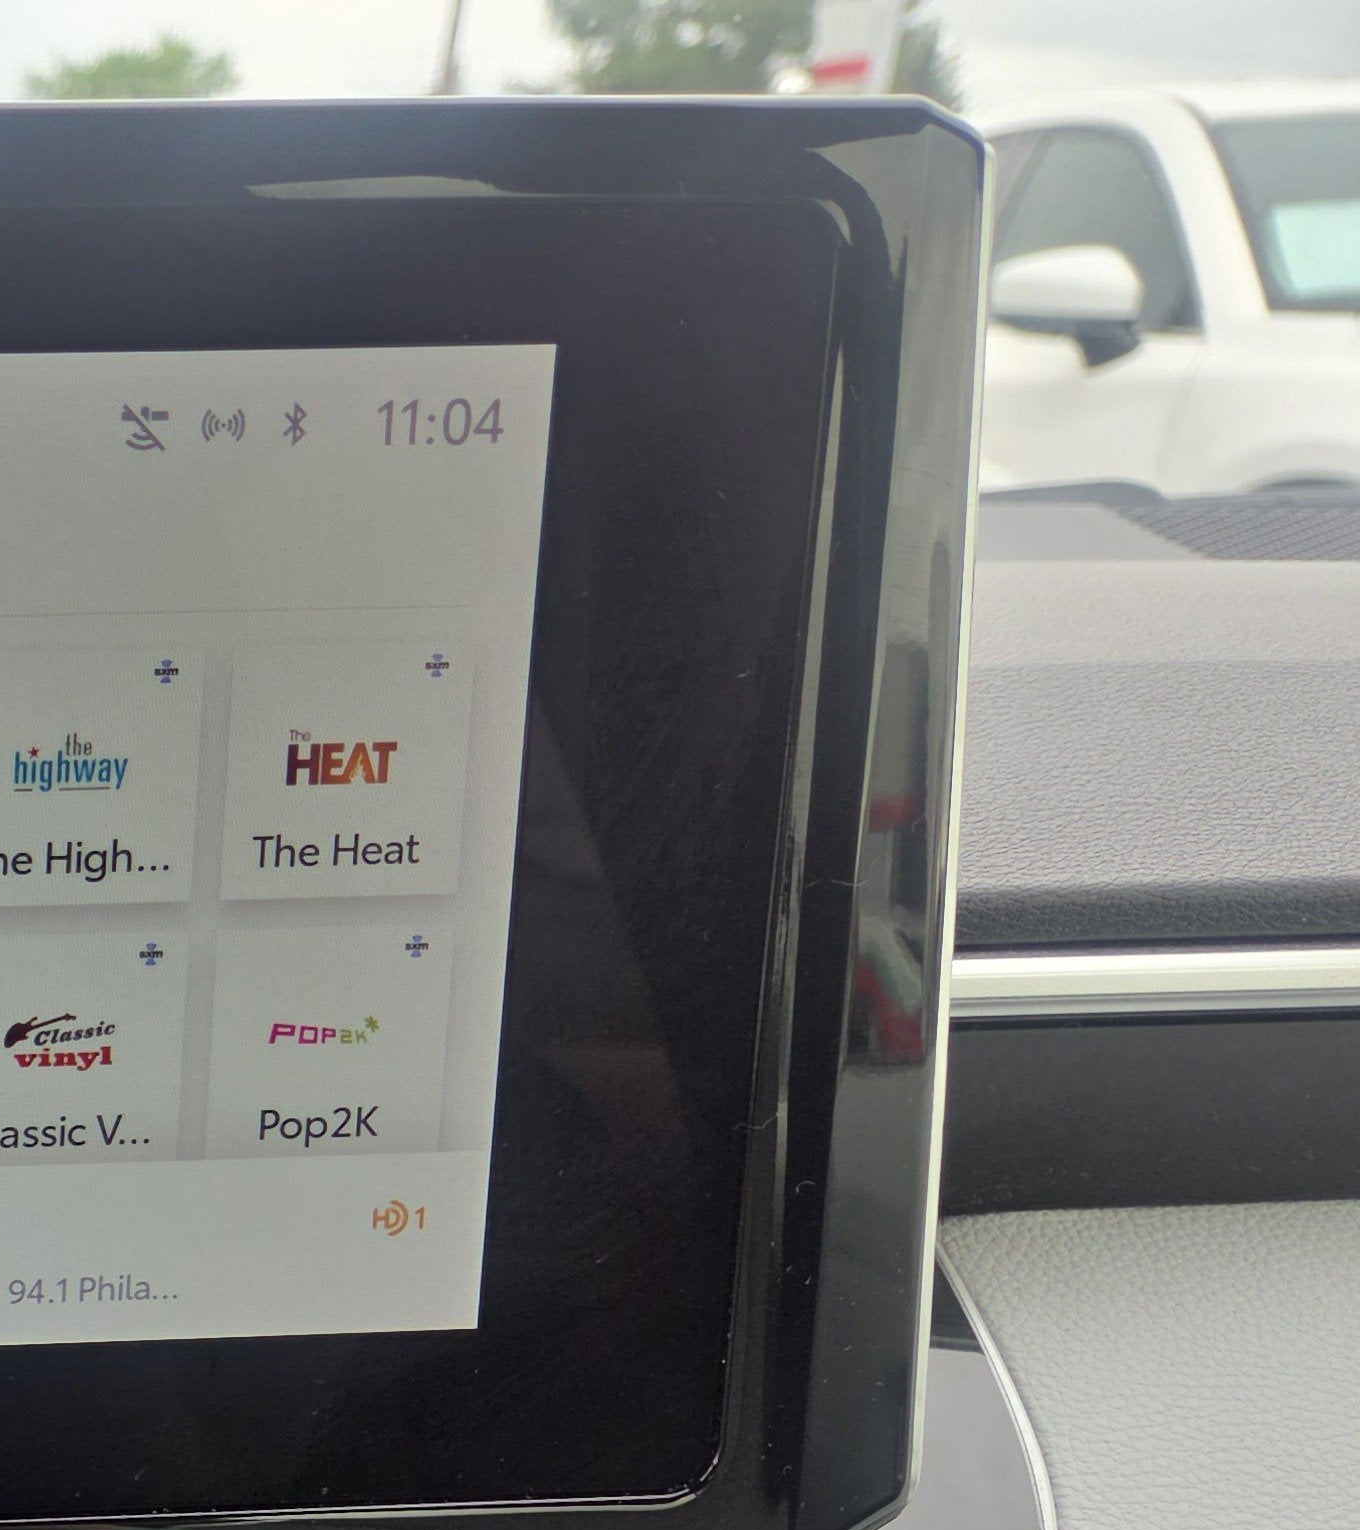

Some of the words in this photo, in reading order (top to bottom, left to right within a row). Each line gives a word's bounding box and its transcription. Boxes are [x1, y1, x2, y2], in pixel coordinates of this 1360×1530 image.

[377, 398, 504, 447] 11:04
[65, 732, 93, 756] the
[289, 729, 312, 742] The
[13, 750, 128, 792] highway
[285, 741, 398, 786] HEAT
[254, 835, 322, 870] The
[332, 833, 421, 867] Heat
[34, 1020, 116, 1046] Classic
[13, 1046, 113, 1071] vinyl
[259, 1107, 379, 1148] Pop2K
[7, 1278, 69, 1306] 94.1
